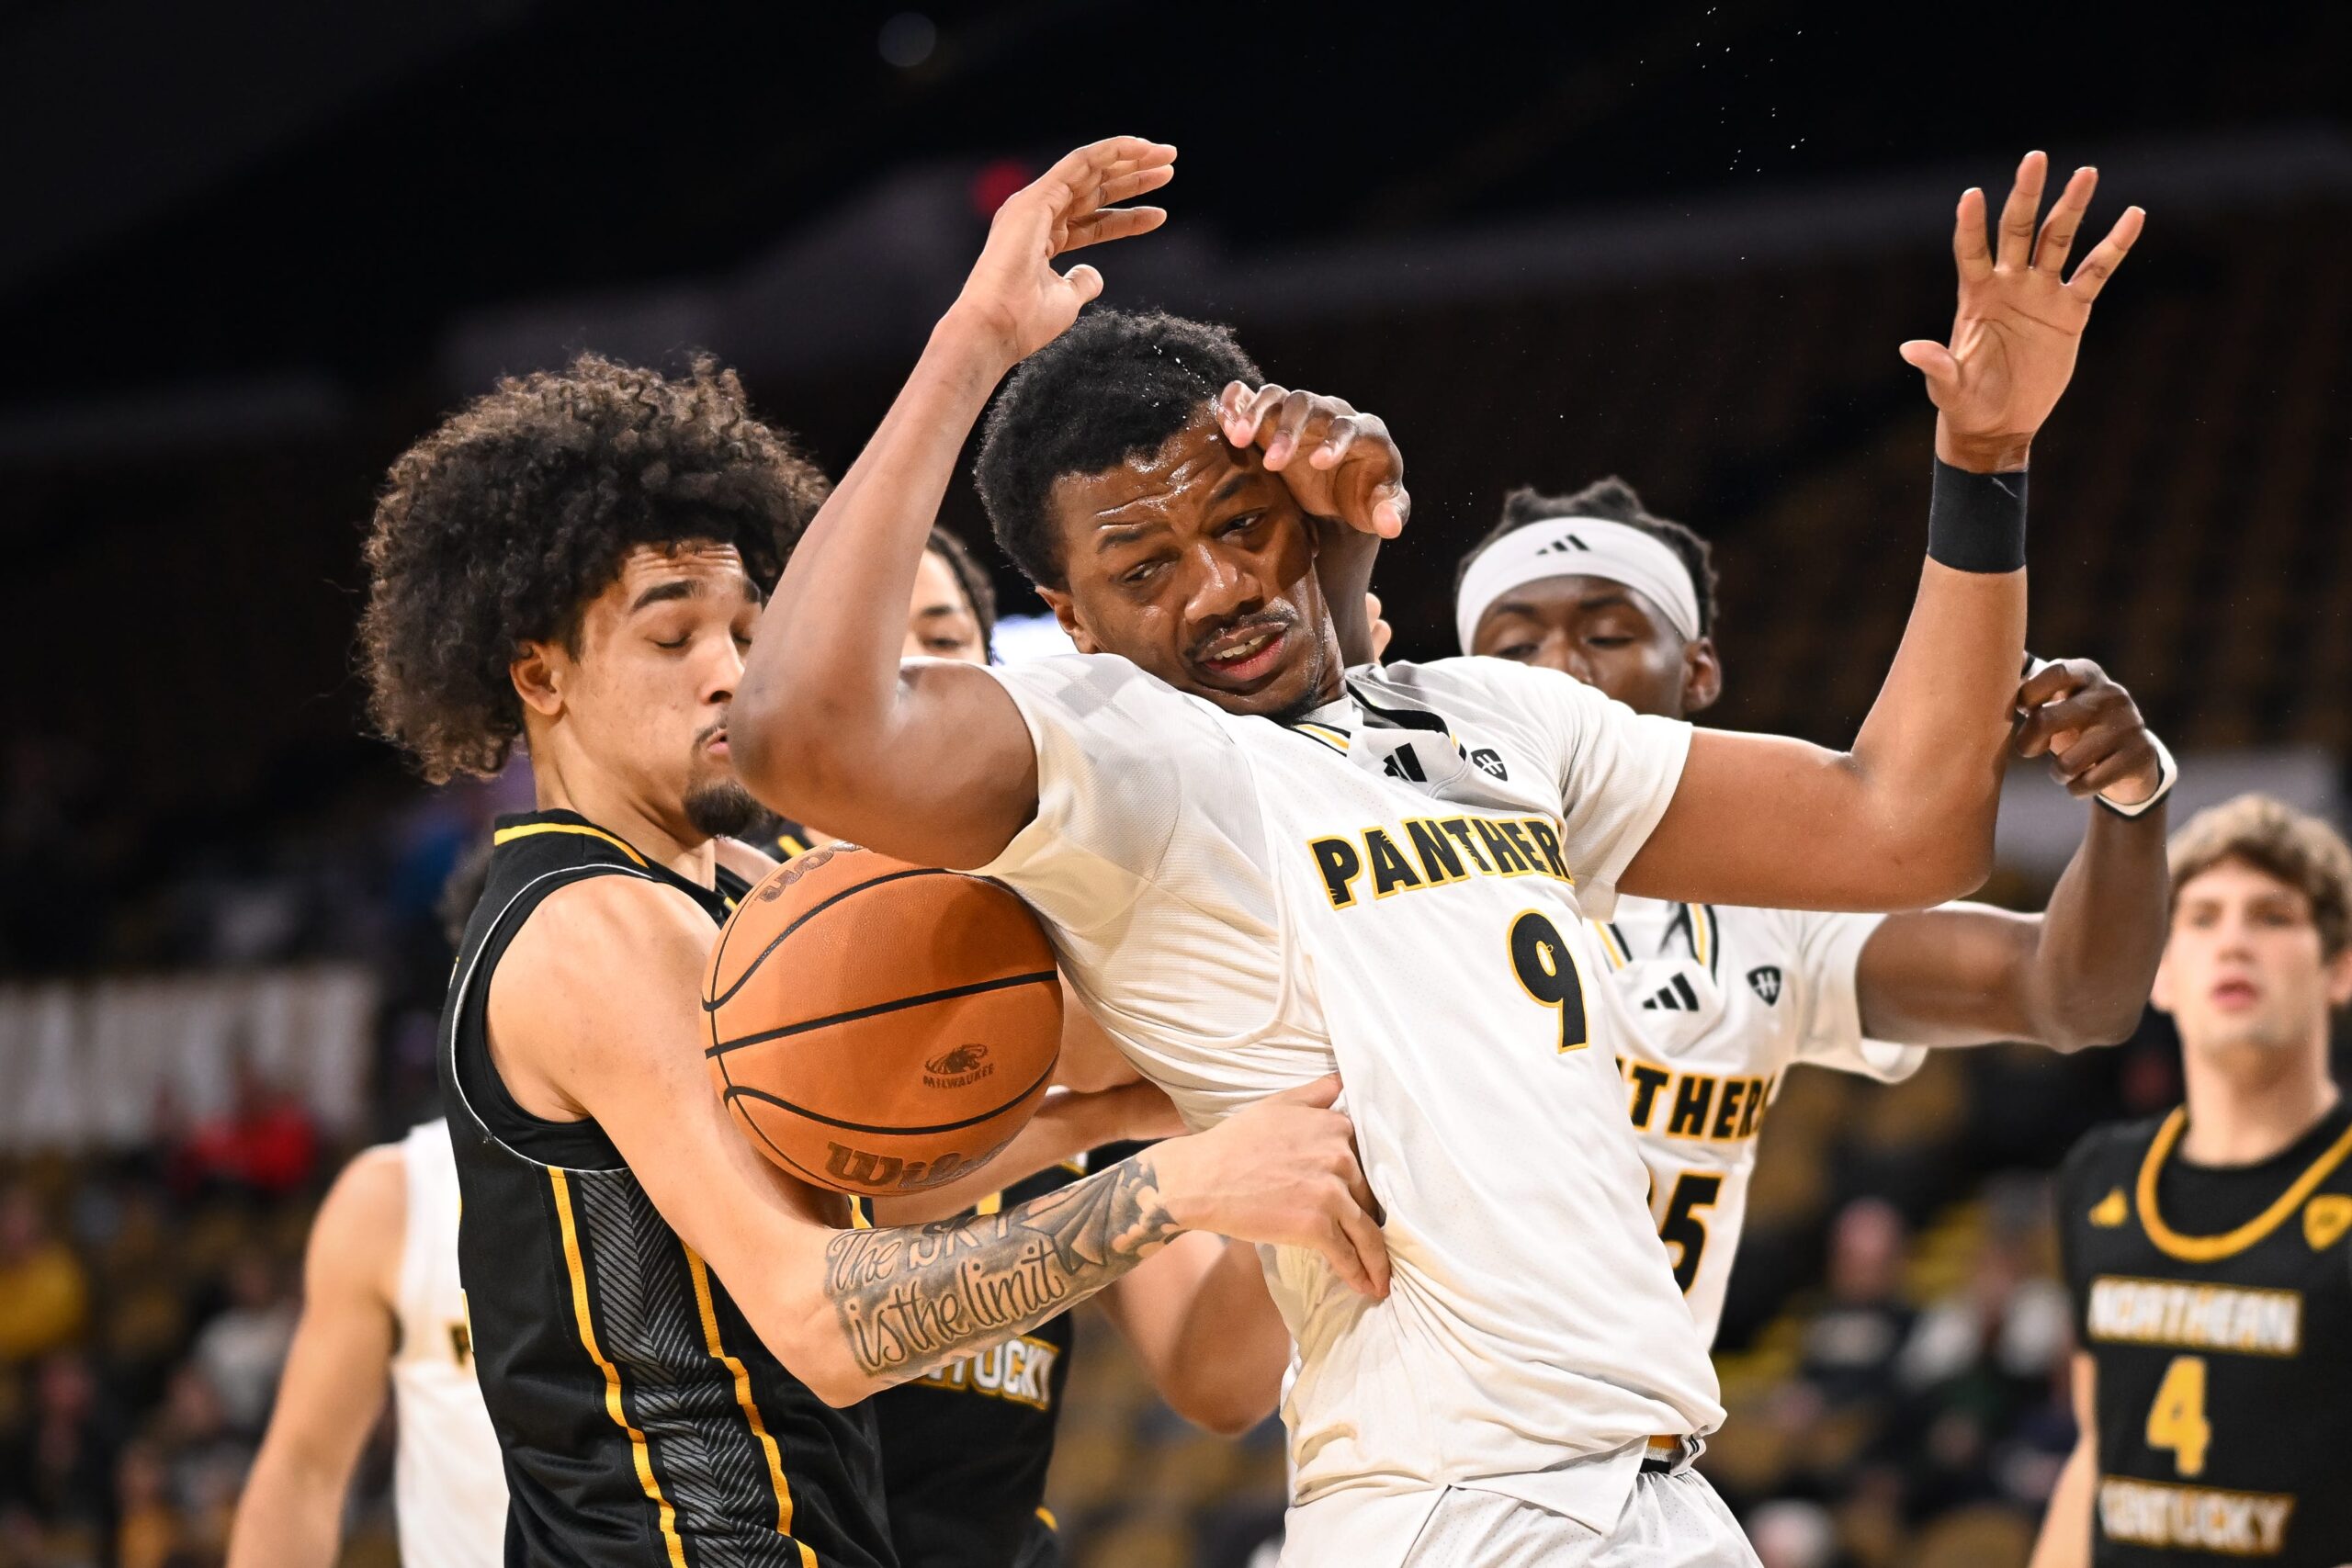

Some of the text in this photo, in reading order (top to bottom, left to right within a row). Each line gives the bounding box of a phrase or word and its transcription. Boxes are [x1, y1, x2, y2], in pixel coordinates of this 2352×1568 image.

[1307, 815, 1575, 911] PANTHER
[1507, 908, 1589, 1054] 9
[922, 1063, 995, 1089] MILWAUKEE
[1615, 1055, 1776, 1145] THER
[826, 1228, 903, 1291] The
[1647, 1170, 1728, 1298] 5
[2145, 1355, 2212, 1476] 4
